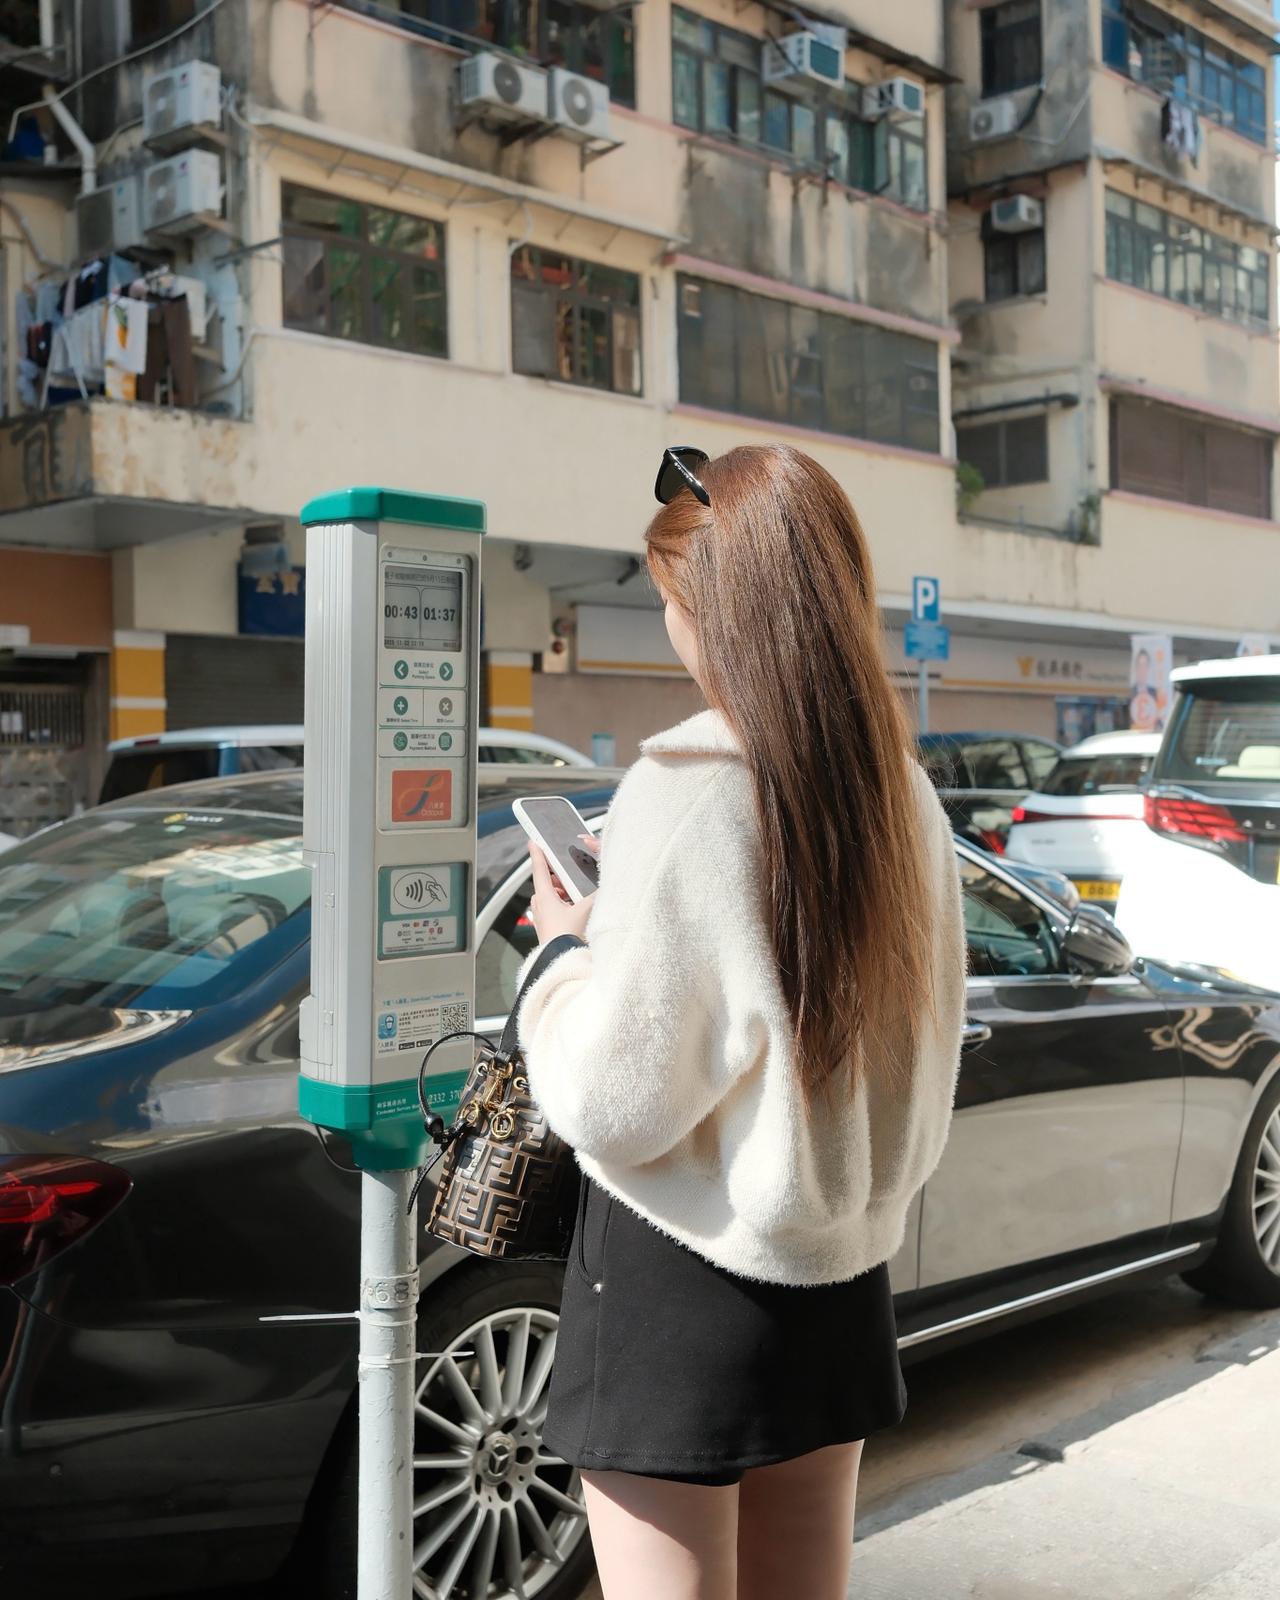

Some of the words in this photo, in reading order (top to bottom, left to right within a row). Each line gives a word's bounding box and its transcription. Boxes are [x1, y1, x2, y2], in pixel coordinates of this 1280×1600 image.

[916, 579, 936, 619] P
[384, 604, 419, 620] 00:43
[423, 607, 456, 623] 01:37
[427, 1092, 446, 1105] 2332
